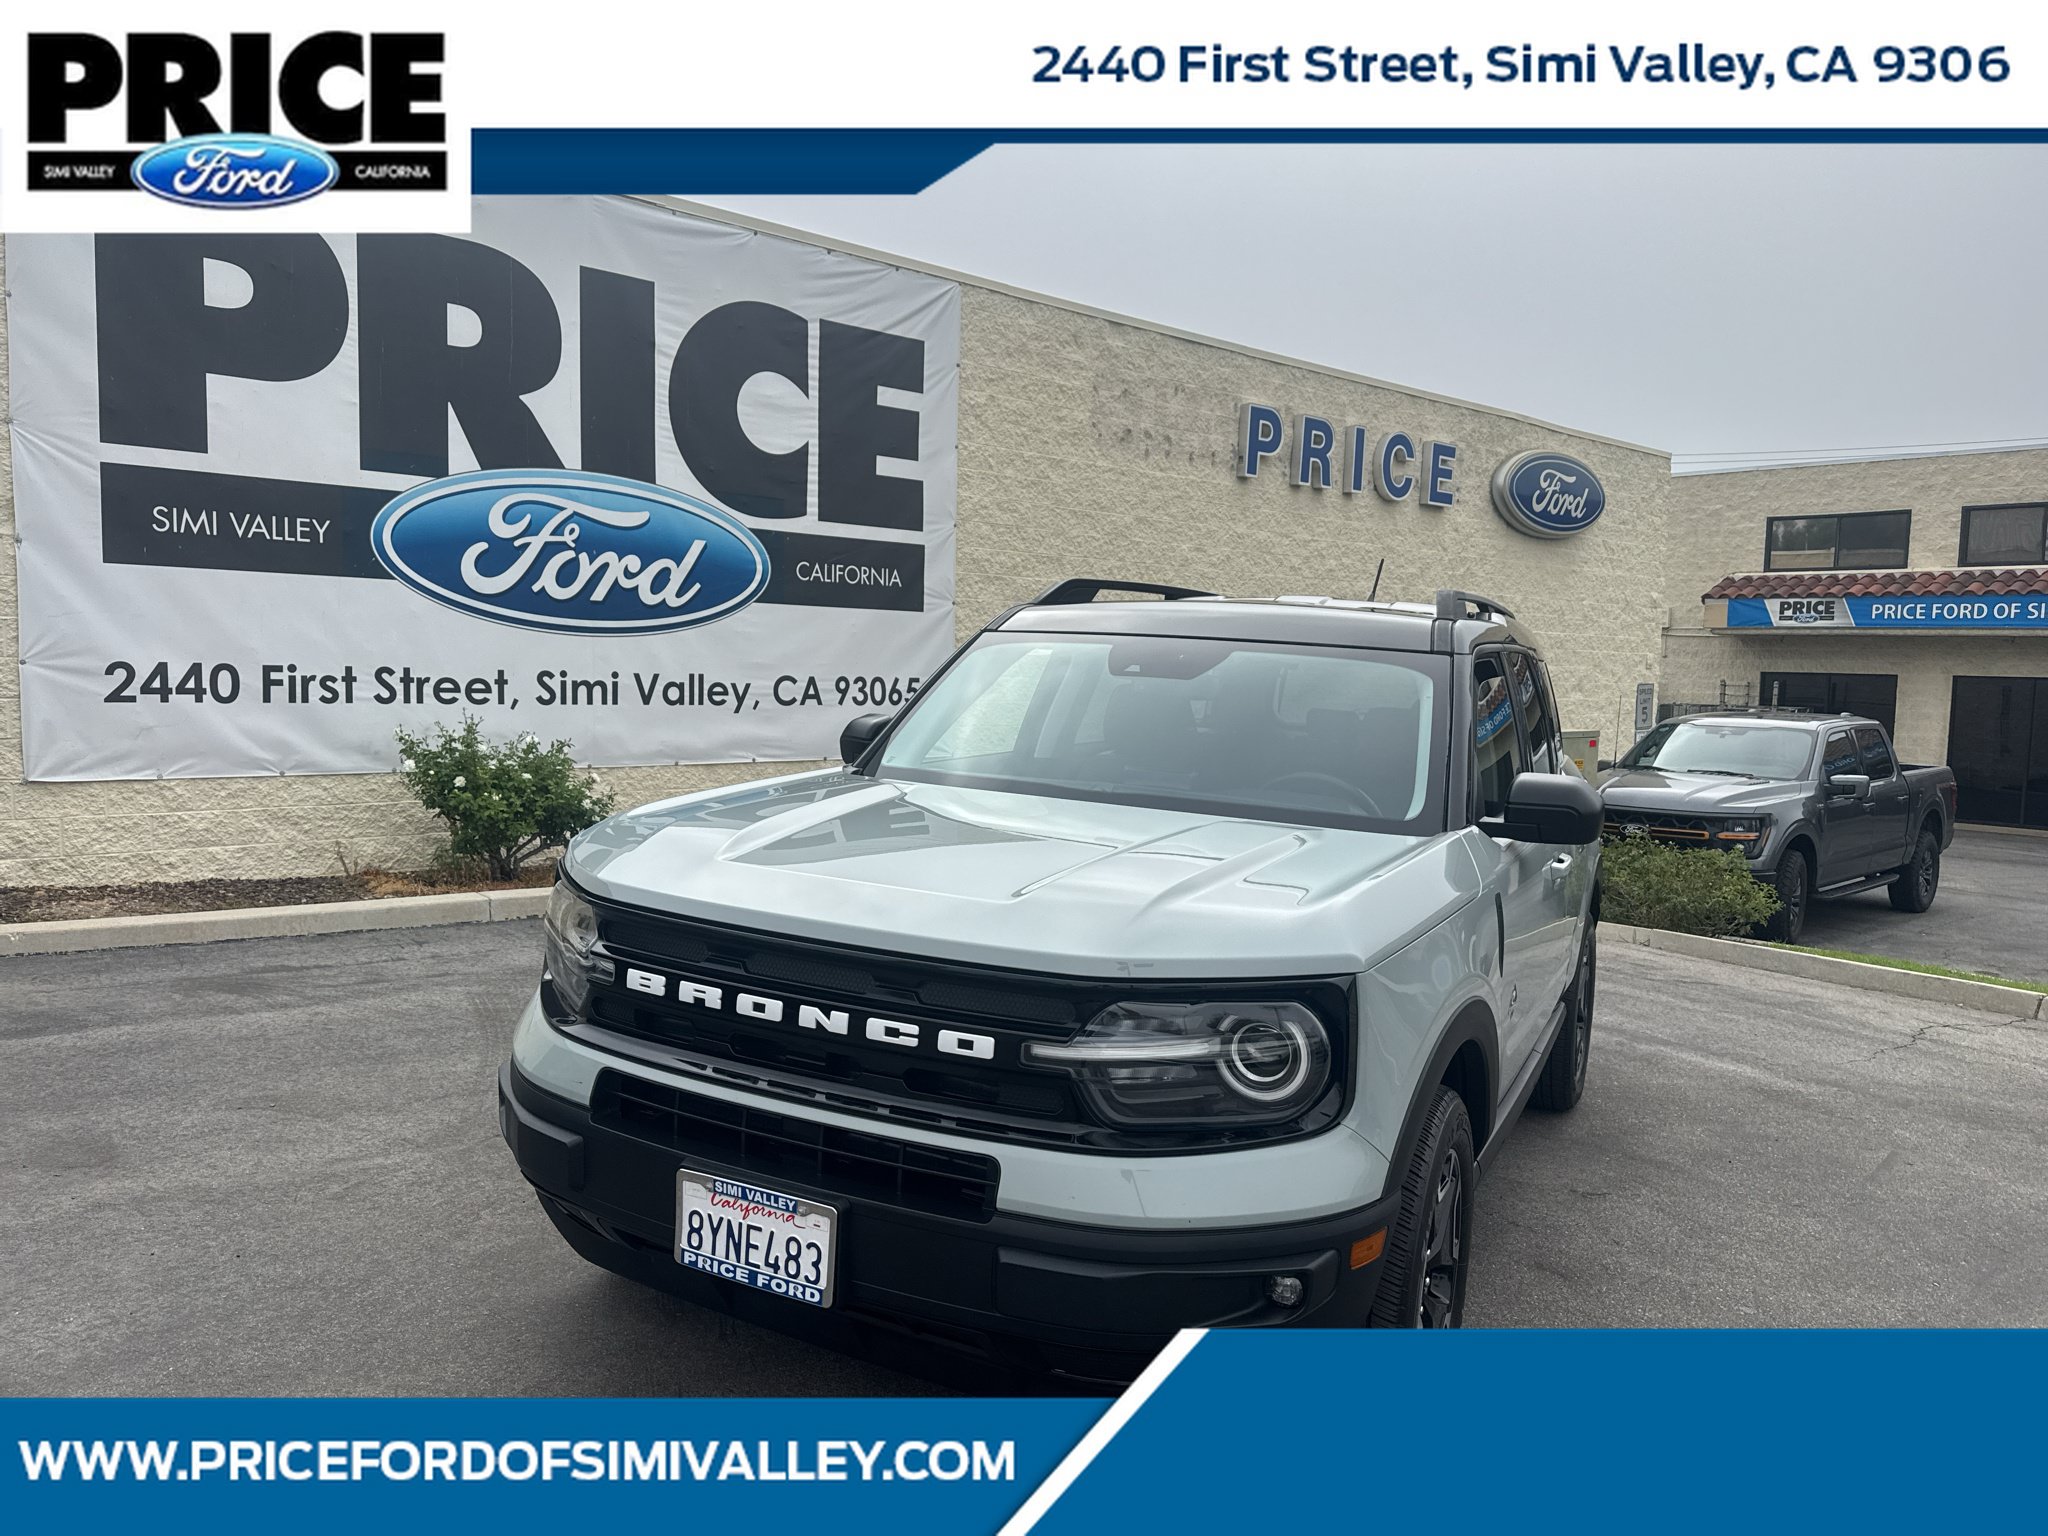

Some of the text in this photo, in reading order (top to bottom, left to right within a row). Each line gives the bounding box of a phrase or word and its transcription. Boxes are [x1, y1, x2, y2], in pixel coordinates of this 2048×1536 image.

[95, 234, 926, 531] PRICE
[1240, 403, 1457, 507] PRICE
[1531, 468, 1590, 520] Ford
[152, 505, 331, 544] SIMI VALLEY
[460, 492, 707, 607] Ford
[795, 561, 902, 588] CALIFORNIA
[1779, 600, 1835, 615] PRICE
[1871, 603, 1927, 620] PRICE
[1931, 603, 1988, 619] FORD
[1993, 603, 2022, 619] OF
[103, 660, 241, 704] 2440
[262, 663, 358, 704] First
[373, 666, 519, 710] Street,
[535, 669, 619, 706] Simi
[633, 672, 760, 714] Valley,
[773, 675, 823, 706] CA
[1642, 706, 1648, 724] 5
[626, 968, 995, 1060] BRONCO
[710, 1192, 806, 1229] California
[714, 1181, 797, 1212] SIMI VALLEY
[686, 1209, 823, 1286] 8YNE483
[683, 1251, 821, 1304] PRICE FORD
